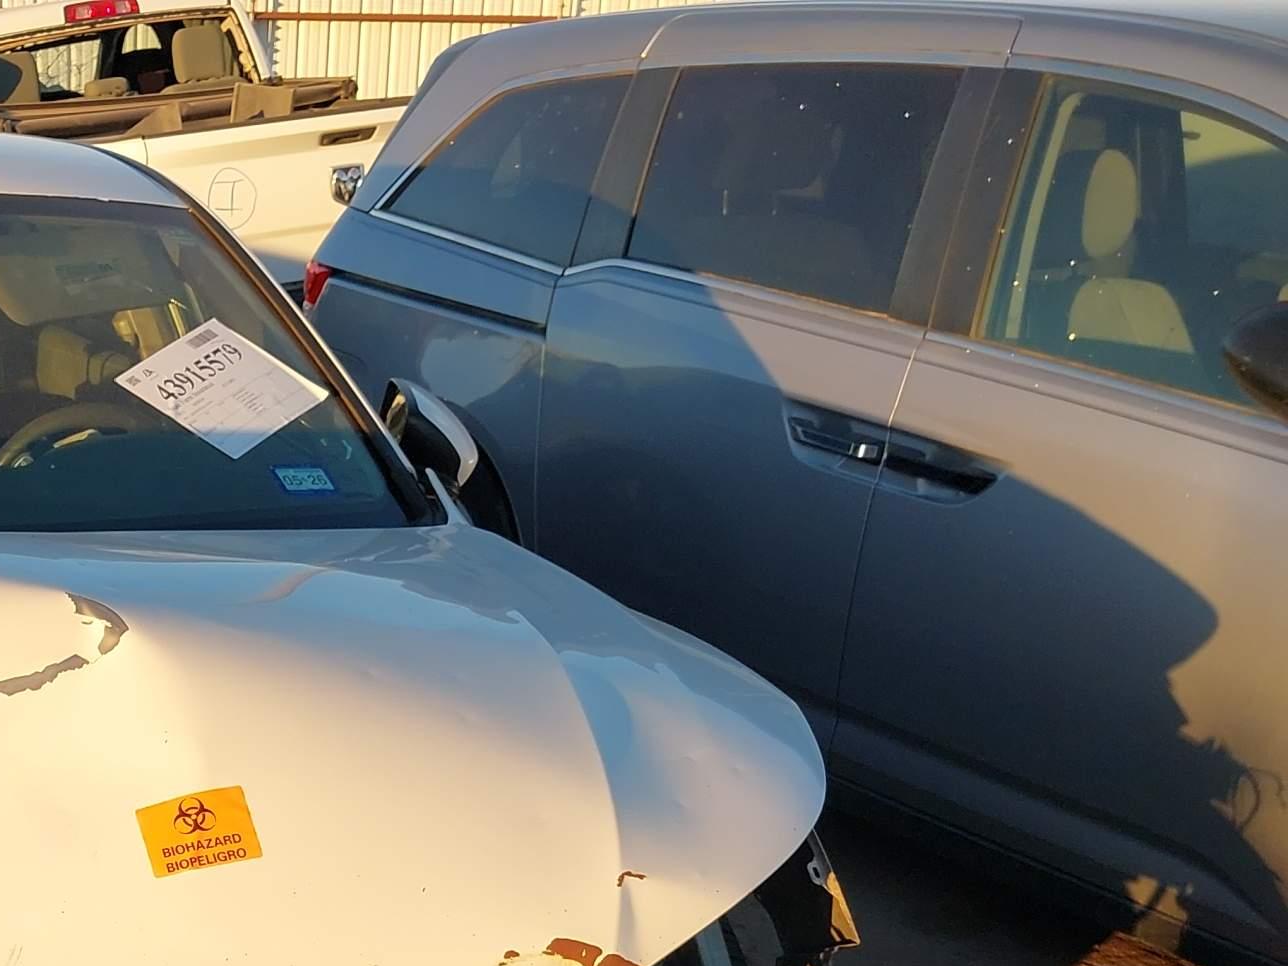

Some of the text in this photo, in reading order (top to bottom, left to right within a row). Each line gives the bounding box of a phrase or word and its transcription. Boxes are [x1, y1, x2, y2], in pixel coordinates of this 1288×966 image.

[157, 342, 243, 400] 43915579
[162, 833, 242, 858] BIOHAZARD
[166, 847, 247, 873] BIOPELIGRO
